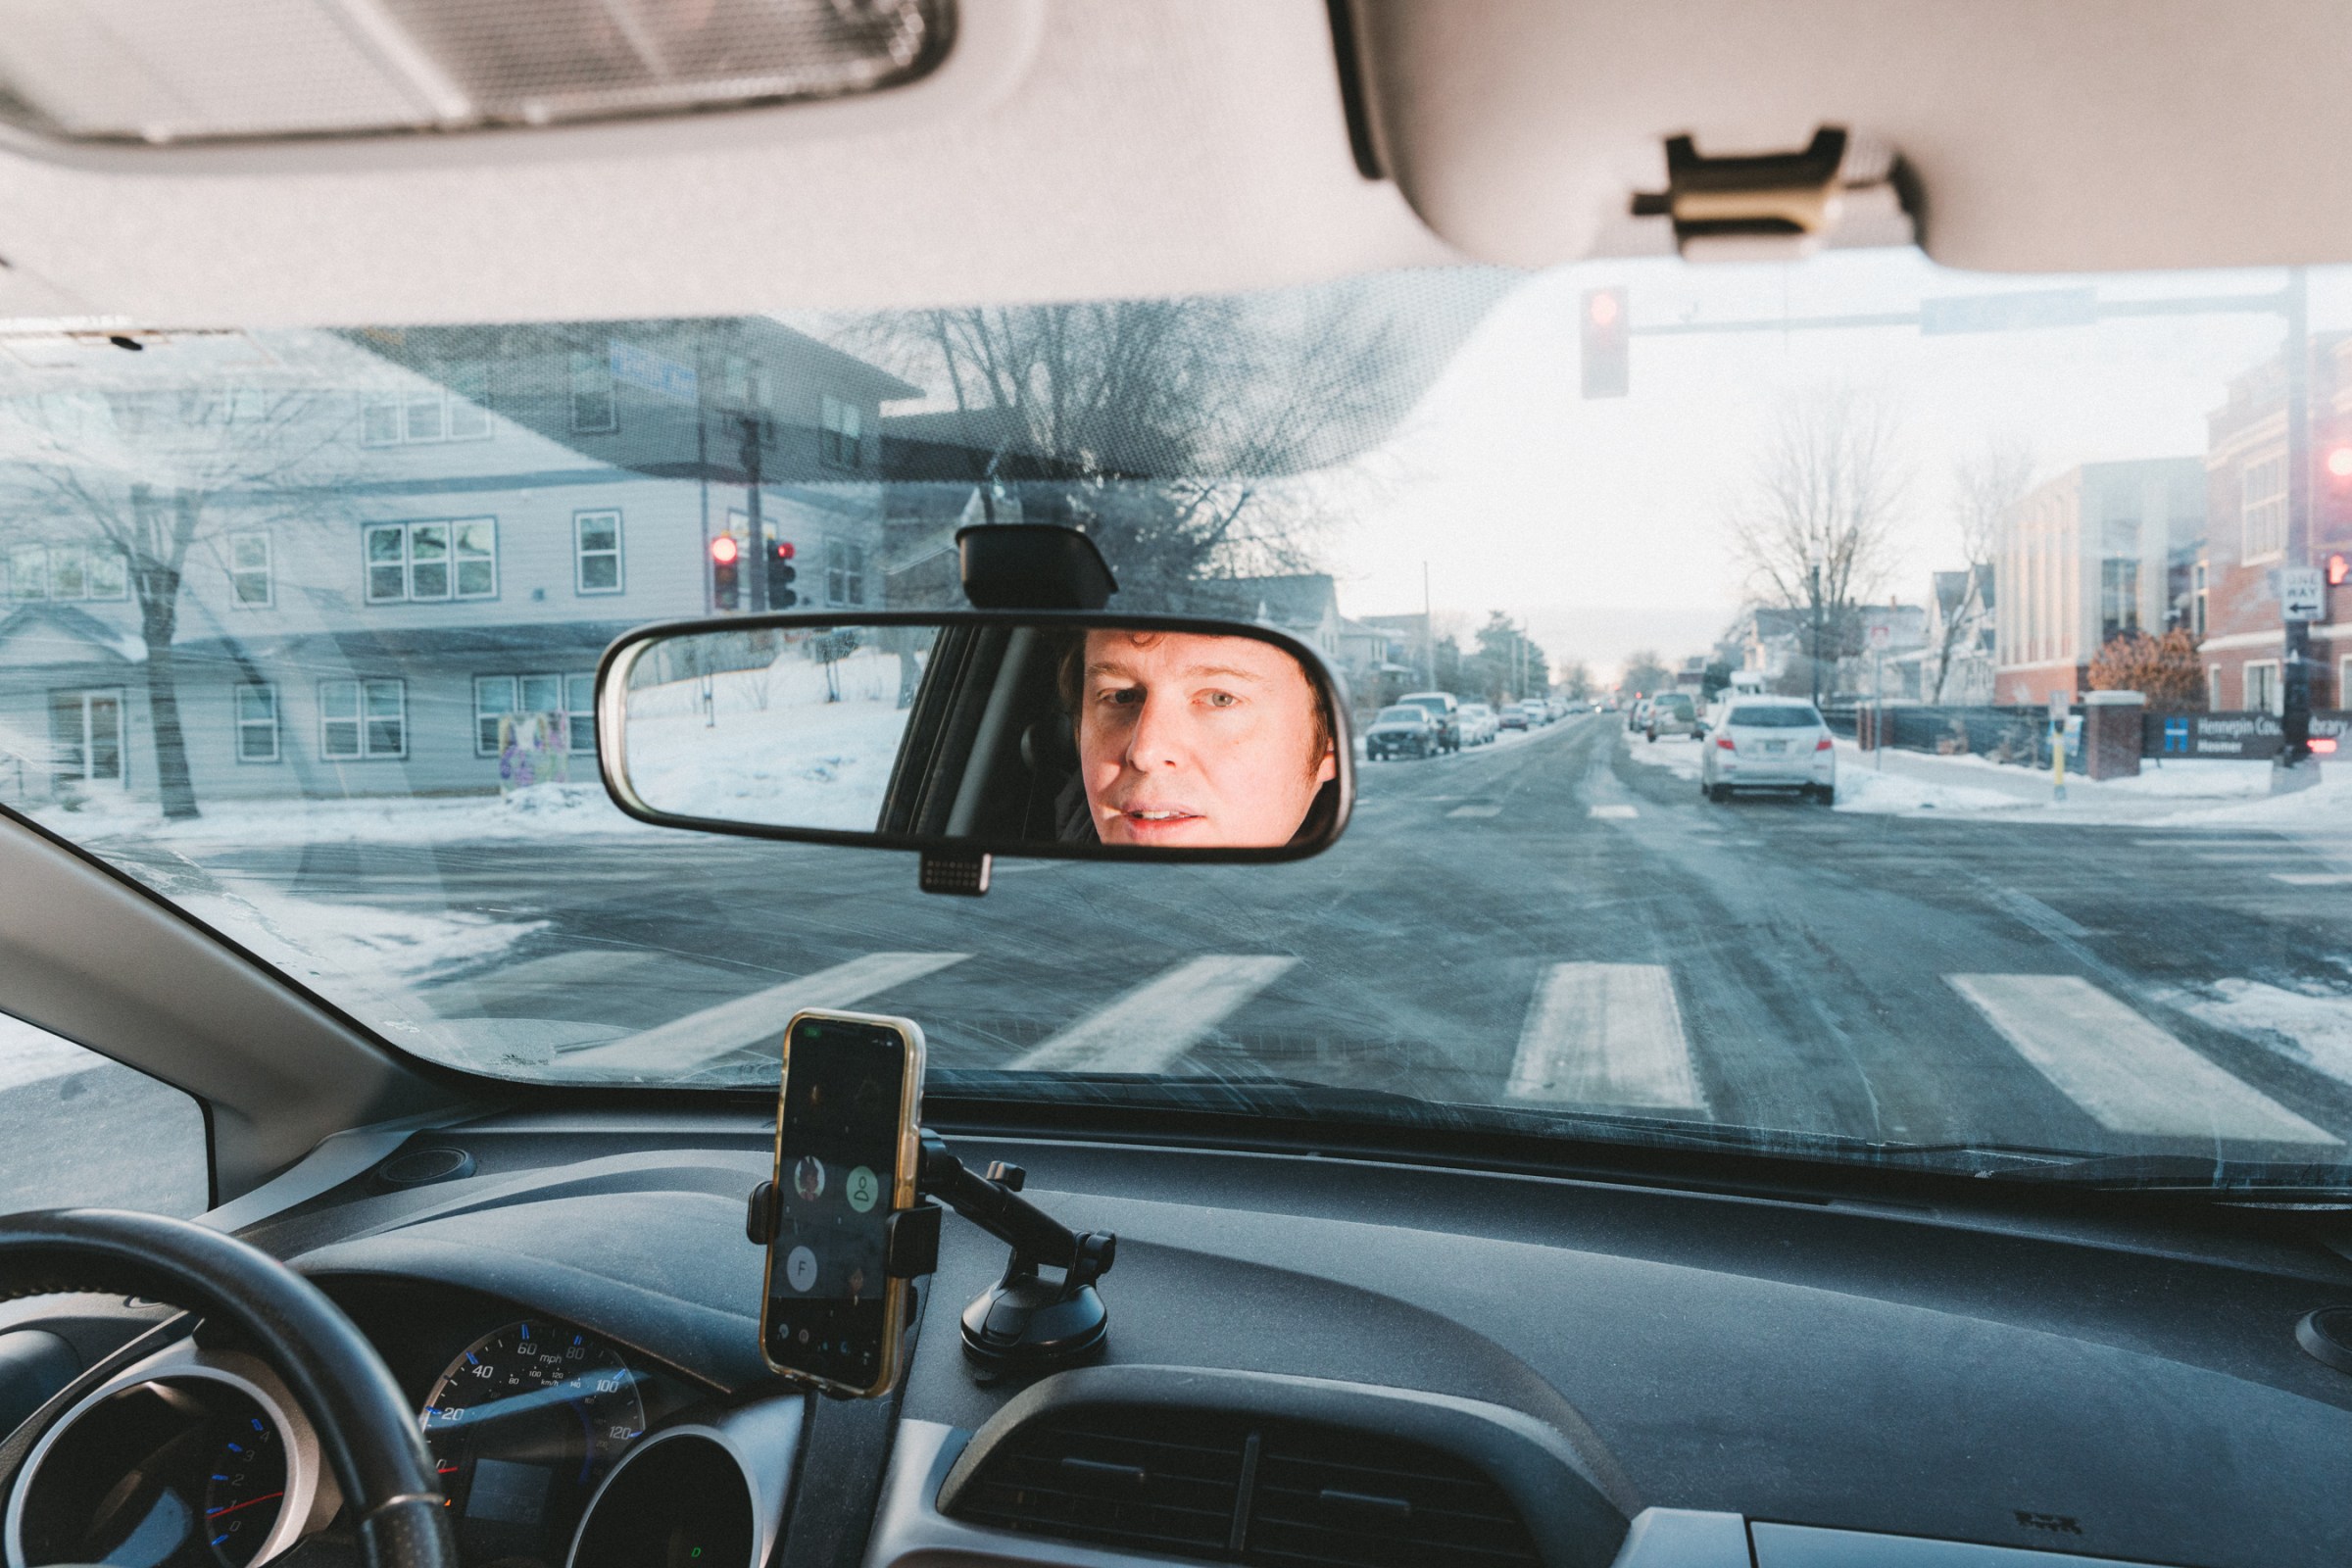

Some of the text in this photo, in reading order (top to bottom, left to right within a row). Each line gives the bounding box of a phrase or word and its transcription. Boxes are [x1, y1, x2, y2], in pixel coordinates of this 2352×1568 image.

[2197, 716, 2254, 740] Hennepin
[798, 1260, 807, 1276] F
[516, 1342, 585, 1360] 60 80
[539, 1353, 563, 1365] mph
[471, 1364, 494, 1379] 40
[541, 1378, 559, 1387] km/h
[596, 1379, 619, 1394] 100
[441, 1407, 465, 1421] 20
[260, 1431, 270, 1443] 4
[609, 1426, 632, 1441] 120
[243, 1449, 255, 1462] 3
[231, 1473, 244, 1487] 2
[229, 1520, 242, 1532] 0
[691, 1546, 702, 1558] D
